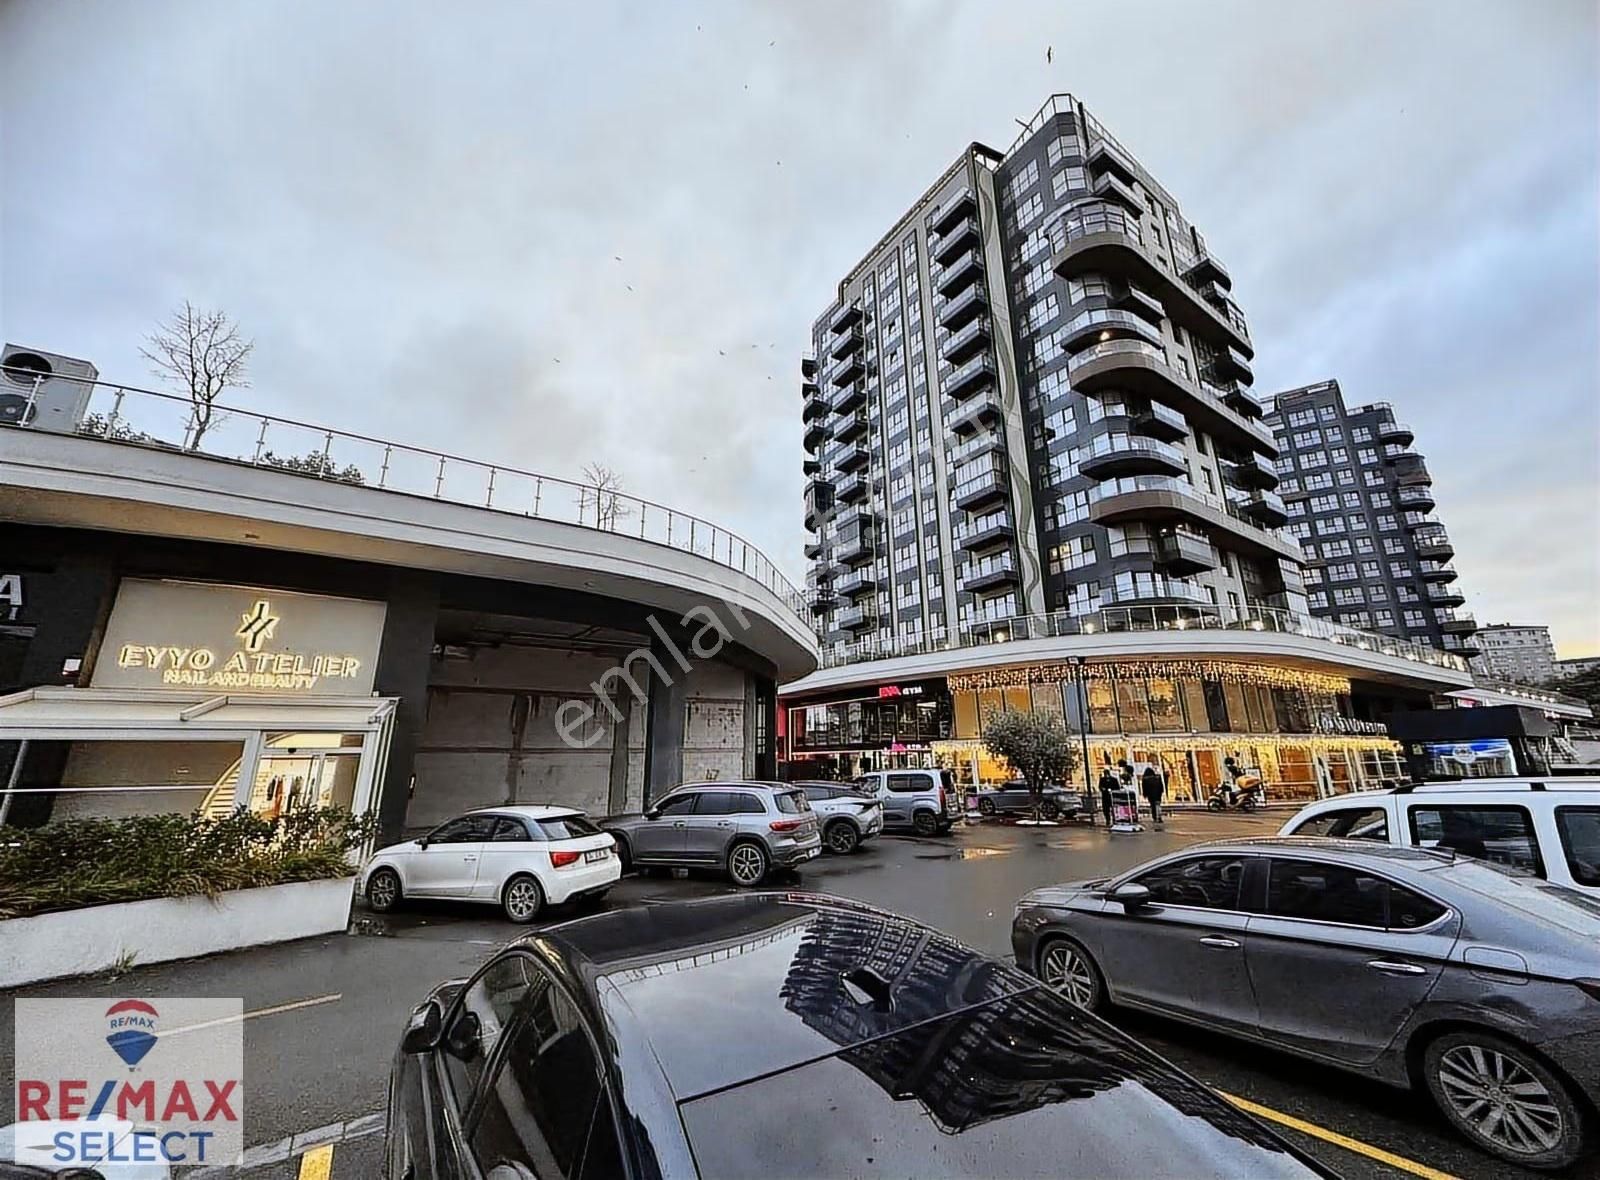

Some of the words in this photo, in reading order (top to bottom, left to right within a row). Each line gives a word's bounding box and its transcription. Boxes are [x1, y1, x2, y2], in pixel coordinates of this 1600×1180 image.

[118, 644, 215, 670] EYYO
[224, 651, 360, 678] ATELIER
[163, 670, 208, 686] NAIL
[208, 672, 250, 687] AND
